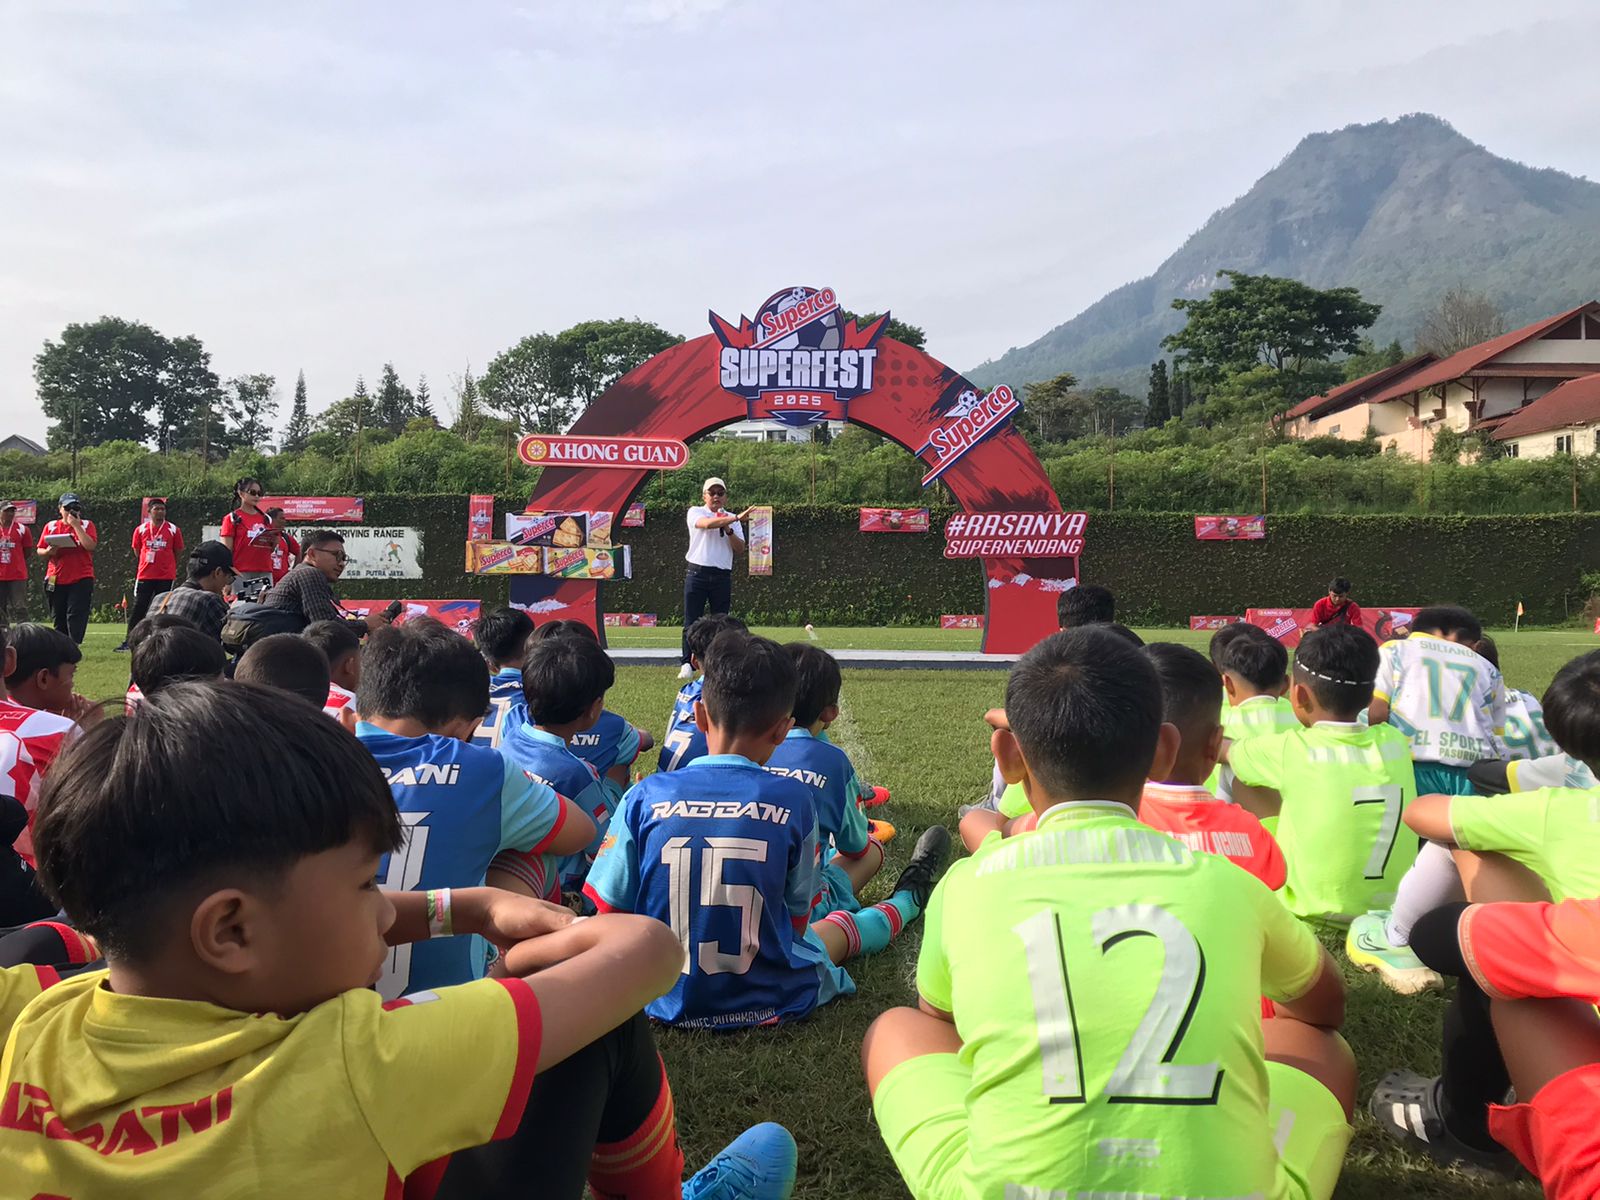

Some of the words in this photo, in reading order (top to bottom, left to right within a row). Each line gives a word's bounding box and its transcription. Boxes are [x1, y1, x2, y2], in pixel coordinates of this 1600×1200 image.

[761, 287, 836, 336] Superco
[720, 346, 877, 390] SUPERFEST
[773, 394, 822, 406] 2025
[929, 385, 1013, 459] Superco
[548, 442, 619, 462] KHONG
[623, 444, 679, 463] GUAN
[373, 529, 405, 538] RANGE
[947, 513, 1086, 537] #RASANYA
[947, 539, 1082, 555] SUPERNENDANG
[1421, 656, 1479, 723] 17
[1414, 729, 1431, 746] EL
[1439, 731, 1485, 752] SPORT
[1352, 784, 1404, 880] 7
[661, 836, 769, 976] 15
[1012, 903, 1225, 1106] 12
